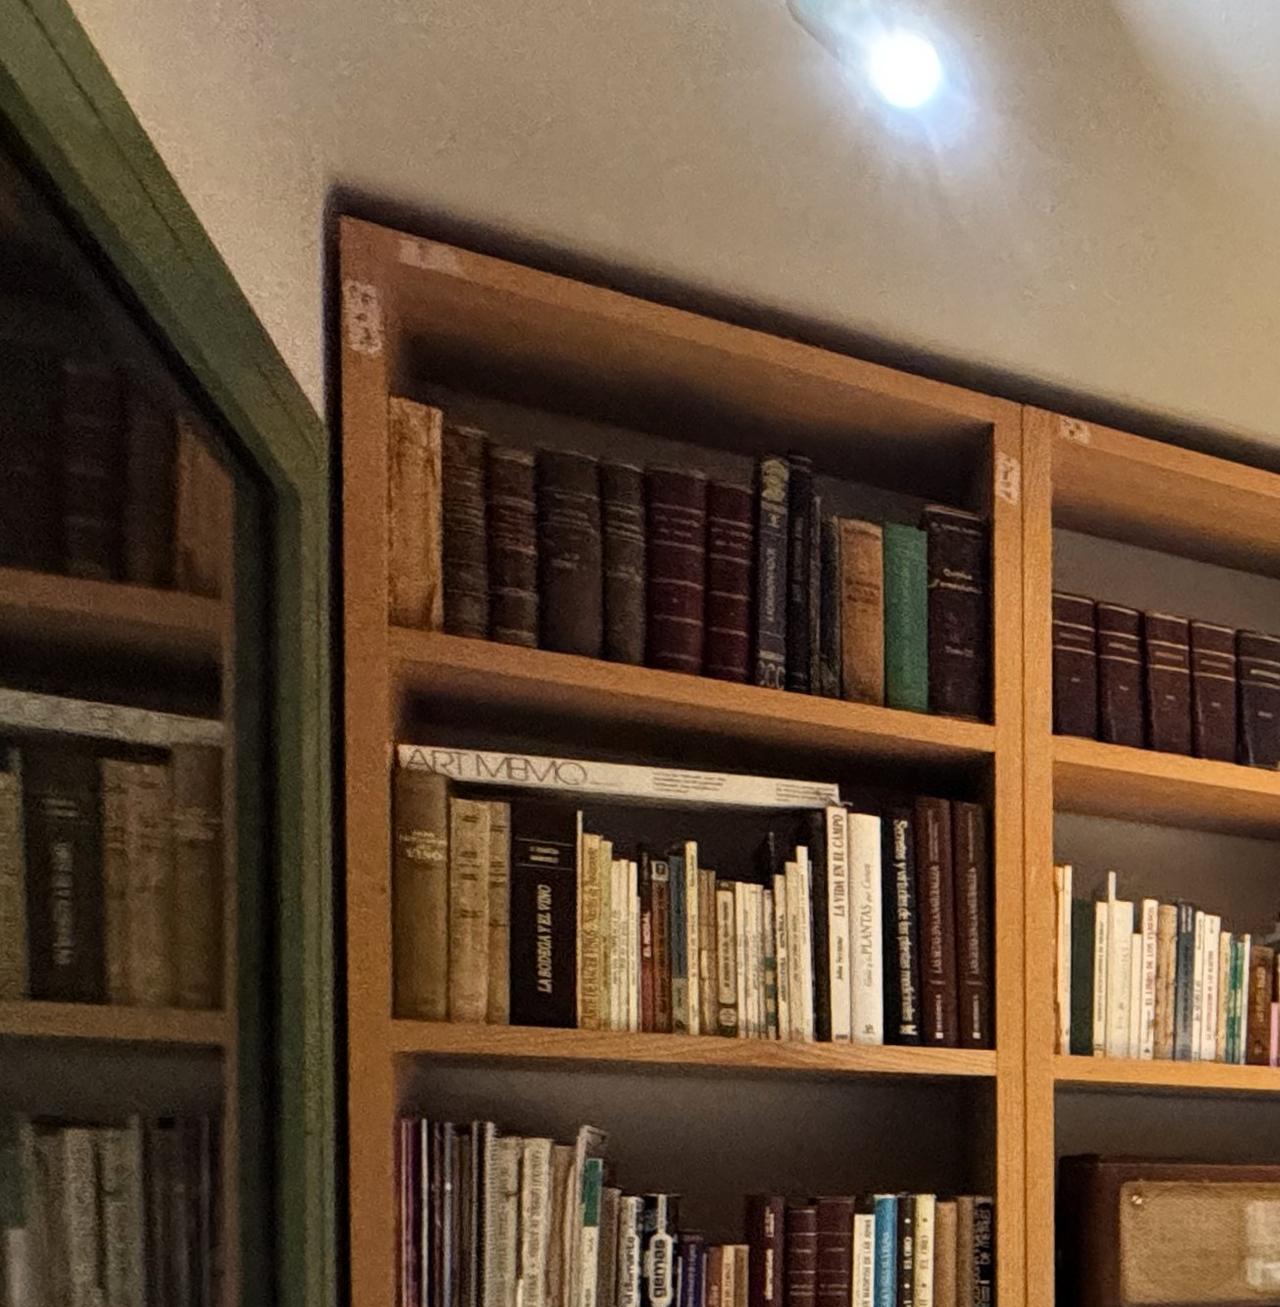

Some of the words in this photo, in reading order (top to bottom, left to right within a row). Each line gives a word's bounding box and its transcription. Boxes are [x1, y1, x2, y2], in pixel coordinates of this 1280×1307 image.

[406, 749, 472, 773] ART
[476, 753, 588, 785] MEMO
[832, 852, 844, 862] EL
[833, 865, 844, 877] EN
[537, 884, 551, 910] VINO
[833, 880, 844, 902] VIDA
[538, 913, 551, 925] EL
[833, 905, 845, 917] LA
[860, 904, 873, 955] PLANTAS
[538, 935, 552, 977] BODEGA
[538, 978, 552, 993] LA
[652, 1238, 666, 1298] gemas
